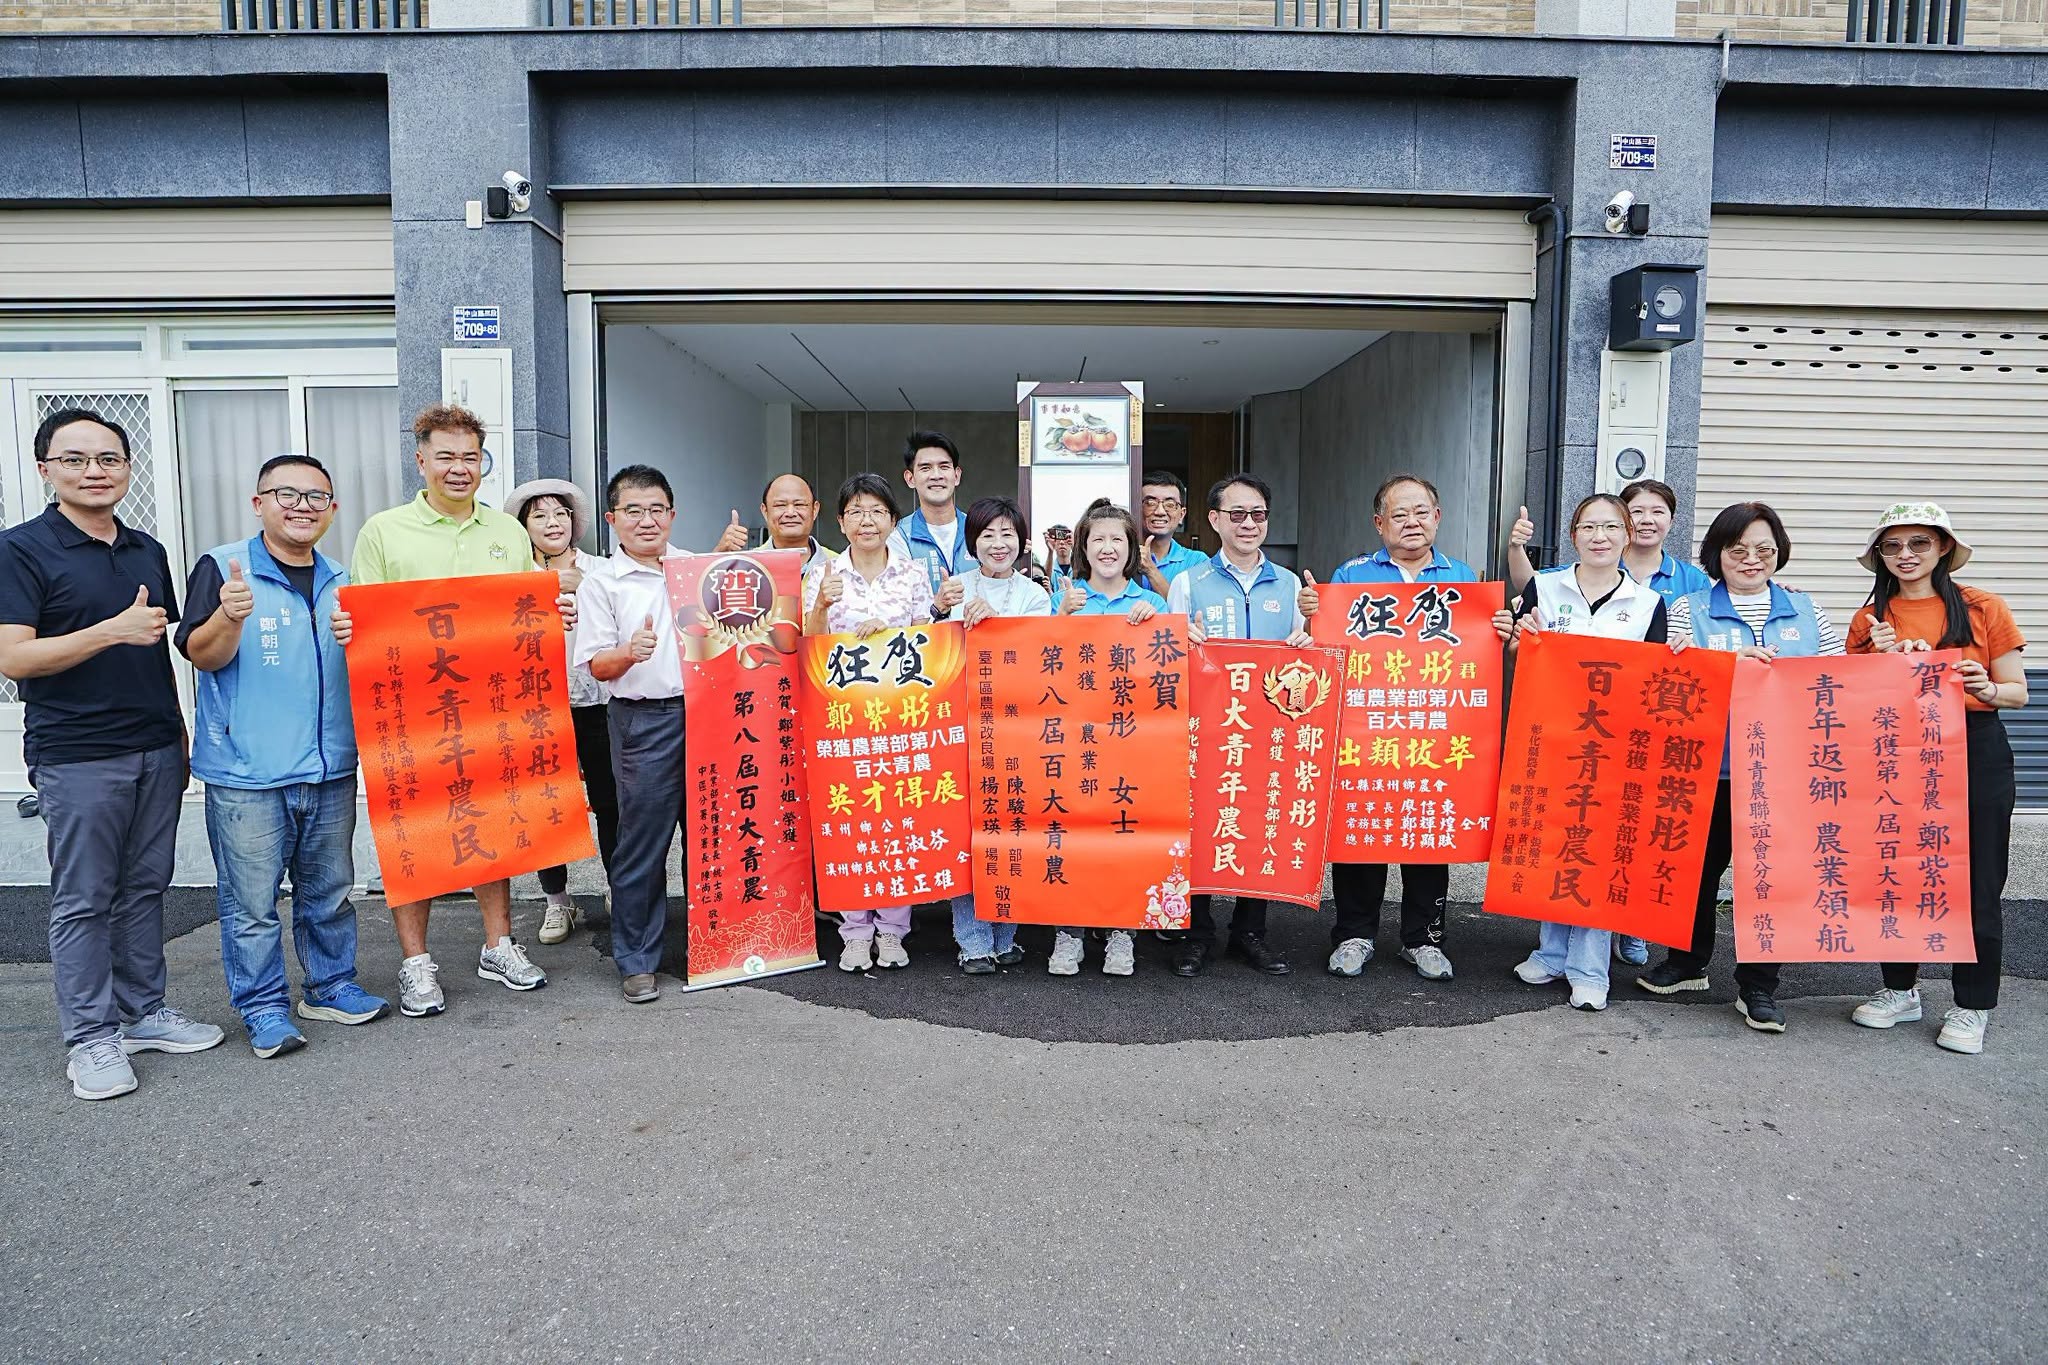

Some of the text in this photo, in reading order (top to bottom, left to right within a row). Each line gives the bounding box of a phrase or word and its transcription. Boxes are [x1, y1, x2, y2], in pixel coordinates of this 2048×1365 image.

[709, 569, 762, 620] 賀
[1346, 585, 1463, 647] 狂賀
[259, 617, 280, 666] 鄭朝元
[826, 630, 935, 688] 狂賀
[1144, 628, 1187, 710] 恭賀
[1347, 649, 1477, 685] 鄭紫彤 君
[370, 682, 387, 711] 會長
[826, 692, 952, 735] 鄭紫彤 君
[978, 650, 995, 770] 臺中區農業改良場
[1078, 643, 1098, 797] 榮獲 農業部
[1346, 688, 1488, 708] 獲農業部第八屆
[1367, 710, 1448, 730] 百大青農
[1651, 679, 1697, 717] 賀
[414, 603, 498, 866] 百大青年農民
[488, 672, 532, 849] 榮獲 農業部第八屆
[777, 678, 798, 843] 恭賀 鄭紫彤小姐 榮獲
[816, 726, 966, 759] 榮獲農業部第八屆
[1107, 644, 1138, 834] 鄭紫彤 女士
[1339, 735, 1476, 771] 出類拔萃
[827, 771, 965, 815] 英才得展
[853, 753, 932, 778] 百大青農
[1038, 645, 1069, 885] 第八屆百大青農
[1212, 662, 1257, 876] 百大青年農民
[1336, 778, 1448, 792] 化縣溪州鄉農會
[1549, 661, 1623, 908] 百大青年農民
[540, 783, 564, 825] 女士
[733, 690, 767, 904] 第八屆百大青農
[1006, 777, 1027, 837] 陳駿季
[1260, 727, 1286, 876] 榮獲 農業部第八屆
[1288, 724, 1325, 870] 鄭紫彤 女士
[1345, 801, 1394, 813] 理事長
[1346, 817, 1394, 830] 常務監事
[1606, 728, 1650, 906] 榮獲 農業部第八屆
[1648, 735, 1706, 906] 鄭紫彤 女士
[1807, 673, 1855, 953] 青年返鄉 農業領航
[1871, 706, 1904, 939] 榮獲第八屆百大青農
[1911, 662, 1950, 952] 賀 溪州鄉青農 鄭紫彤 君
[856, 829, 949, 856] 鄉長 江淑芬
[984, 848, 999, 875] 場長
[1009, 848, 1023, 877] 部長
[1747, 721, 1775, 953] 溪州青農聯誼會分會 敬賀
[863, 869, 955, 898] 主席 莊正雄
[995, 885, 1011, 918] 敬賀
